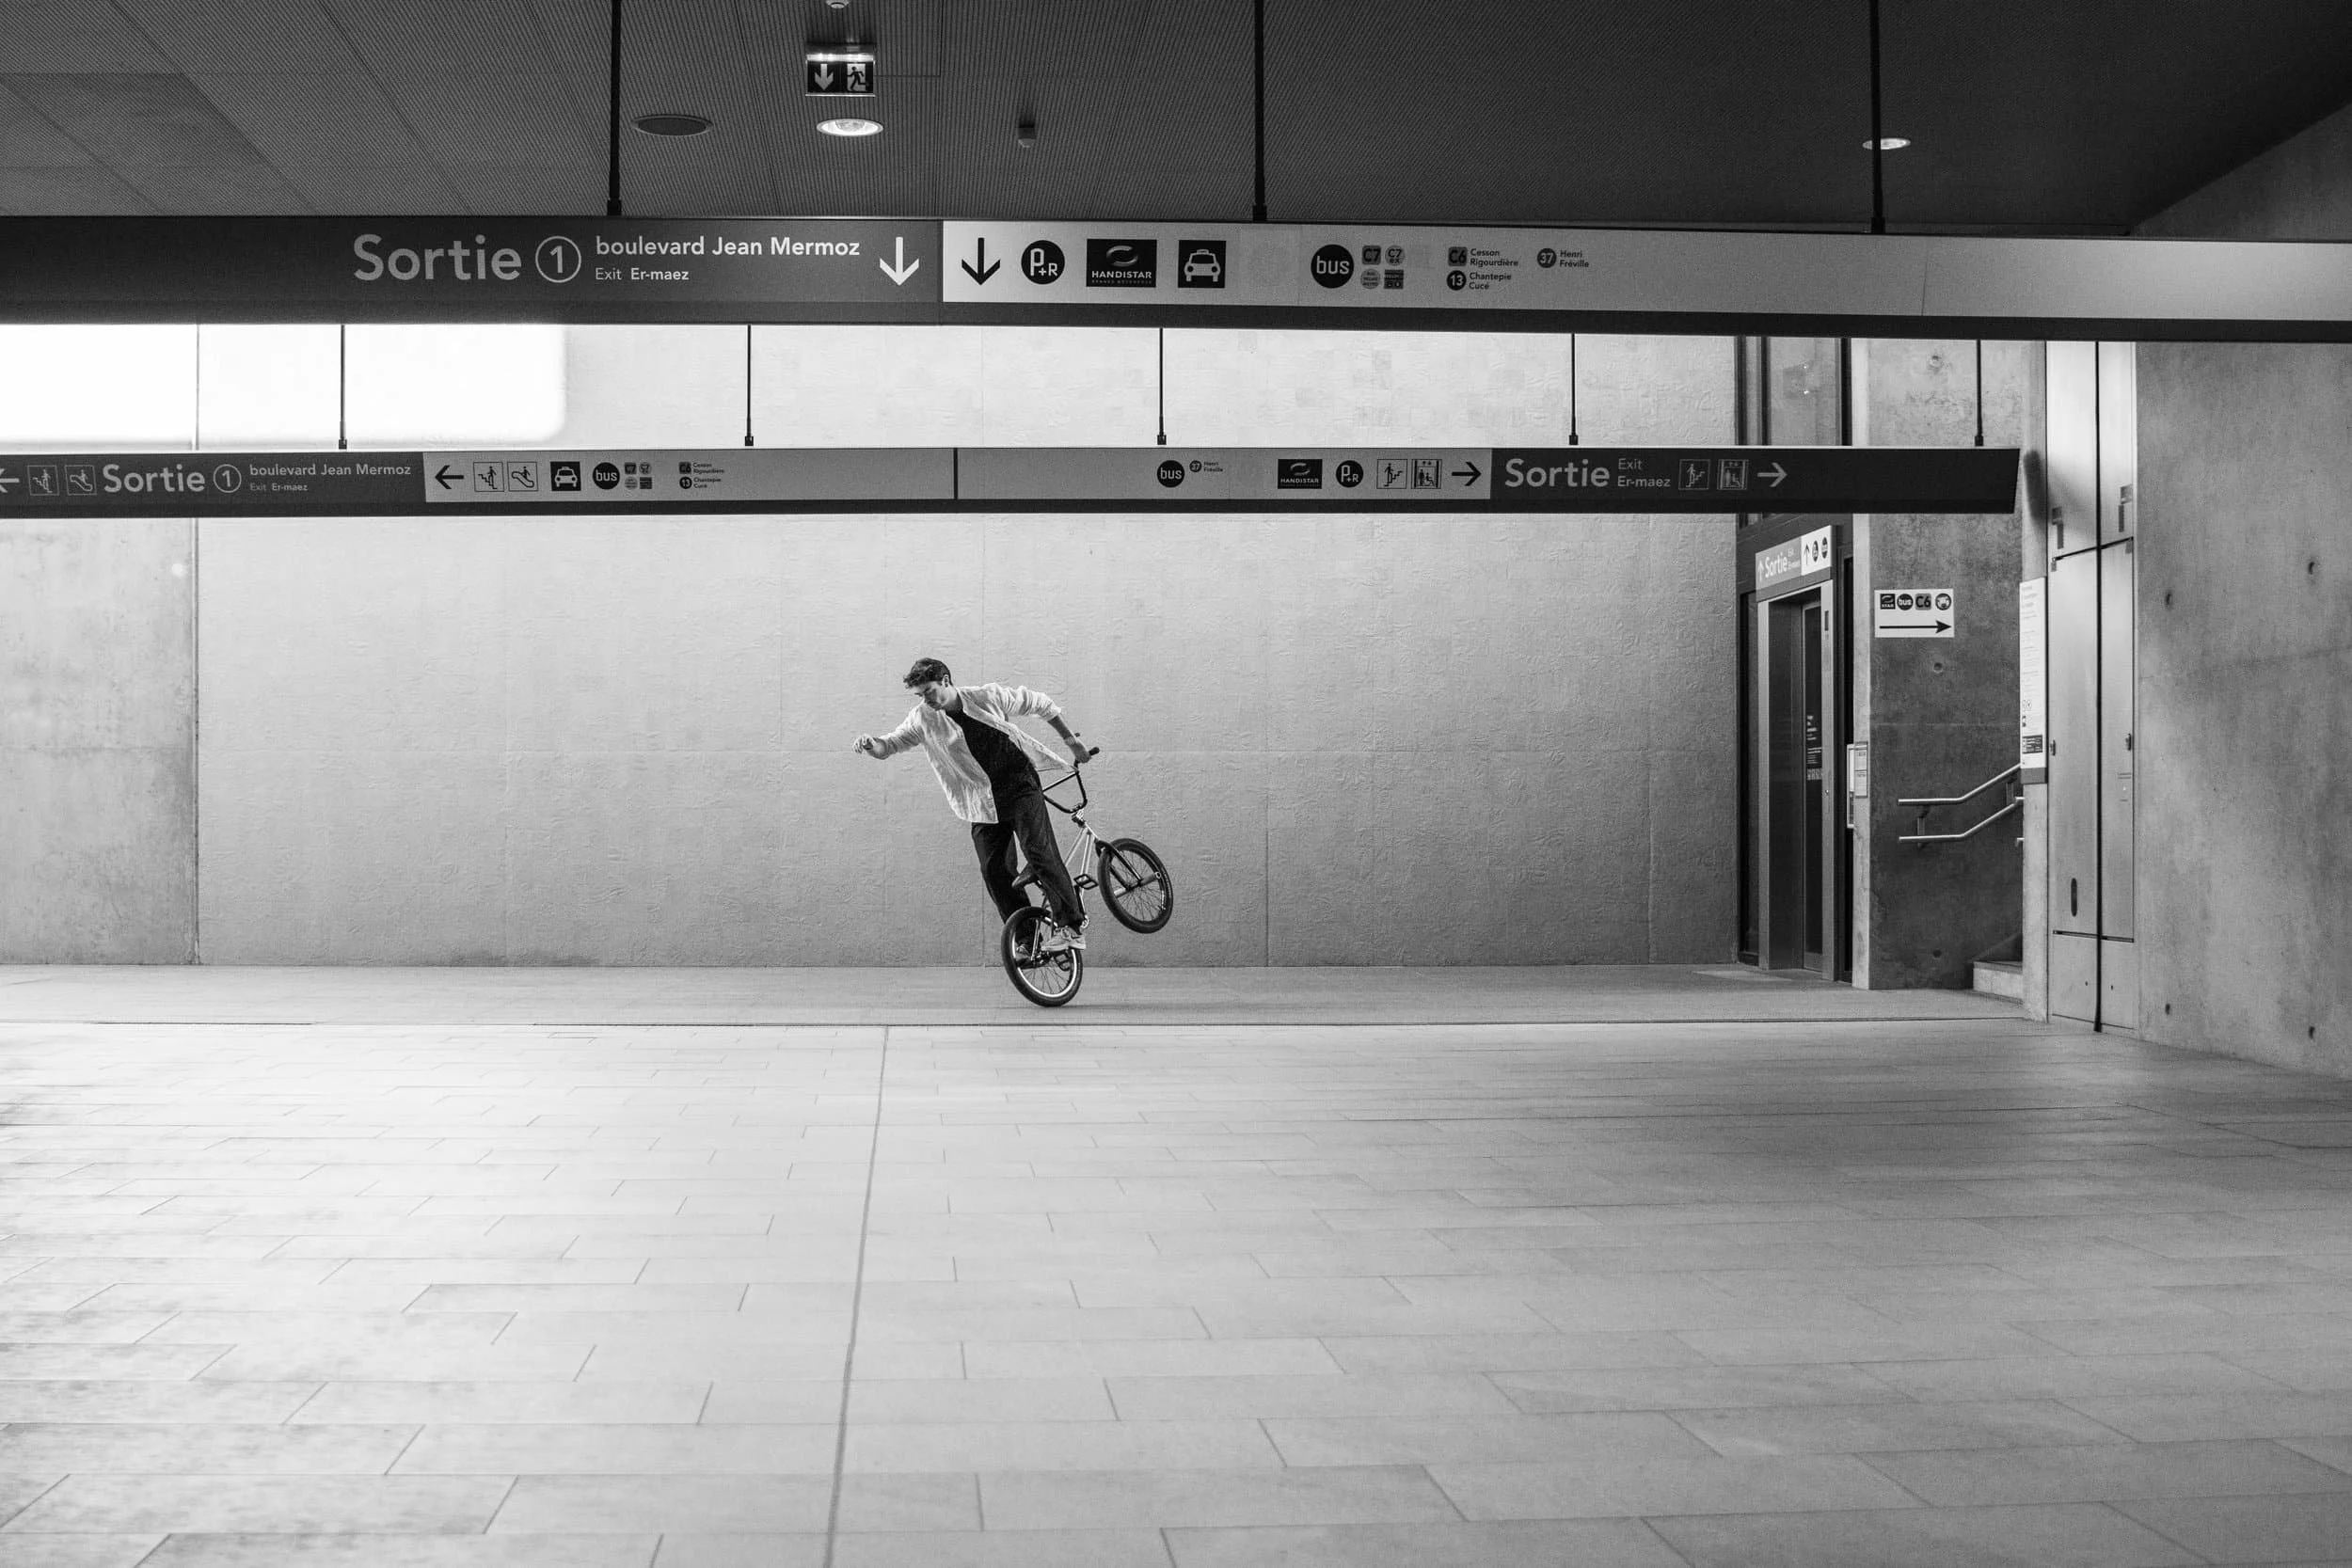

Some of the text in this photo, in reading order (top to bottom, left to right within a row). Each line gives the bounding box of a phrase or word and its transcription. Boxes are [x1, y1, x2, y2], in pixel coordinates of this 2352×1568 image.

[597, 236, 859, 255] boulevard Jean Mermoz
[354, 234, 565, 280] Sortie 1
[1363, 247, 1381, 262] C7
[1450, 249, 1466, 263] C6
[1470, 248, 1500, 257] Cesson
[1540, 251, 1555, 264] 37
[1317, 256, 1349, 274] bus
[1470, 258, 1518, 267] Rigourdière
[596, 268, 689, 279] Exit Er-maez
[1470, 272, 1511, 281] Chantepie
[1450, 275, 1464, 287] 13
[250, 464, 410, 475] boulevard Jean Mermoz
[1618, 458, 1642, 469] Exit
[103, 464, 231, 492] Sortie 1
[596, 470, 618, 482] bus
[1160, 467, 1183, 480] bus
[1505, 458, 1611, 487] Sortie
[1618, 476, 1670, 486] Er-maez
[1765, 552, 1788, 578] Sortie
[1898, 598, 1913, 607] bus
[1915, 595, 1931, 609] C6
